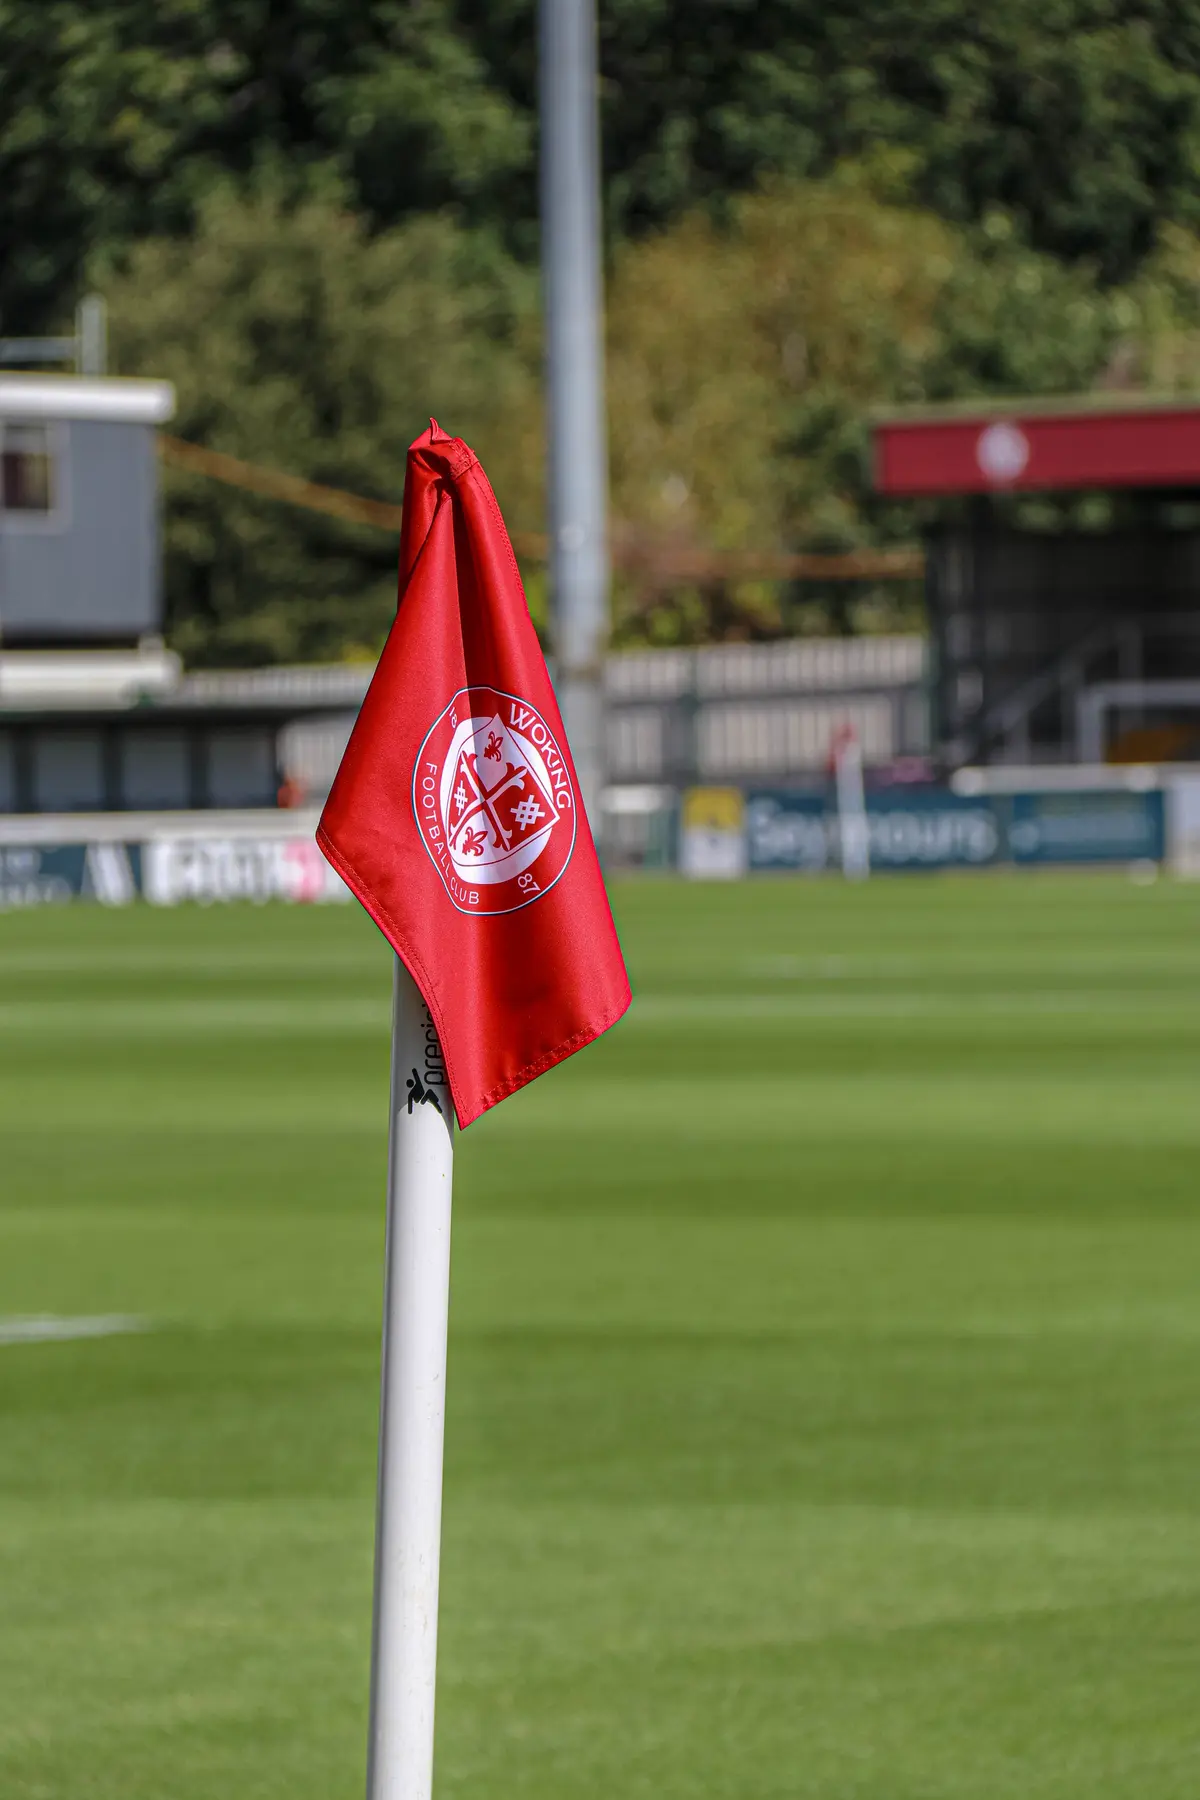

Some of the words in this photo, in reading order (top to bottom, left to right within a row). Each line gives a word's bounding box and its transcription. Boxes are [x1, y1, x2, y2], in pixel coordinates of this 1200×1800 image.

[510, 703, 571, 809] WOKING
[422, 762, 451, 878] FOOTBALL
[450, 876, 480, 905] CLUB
[517, 872, 541, 894] 87
